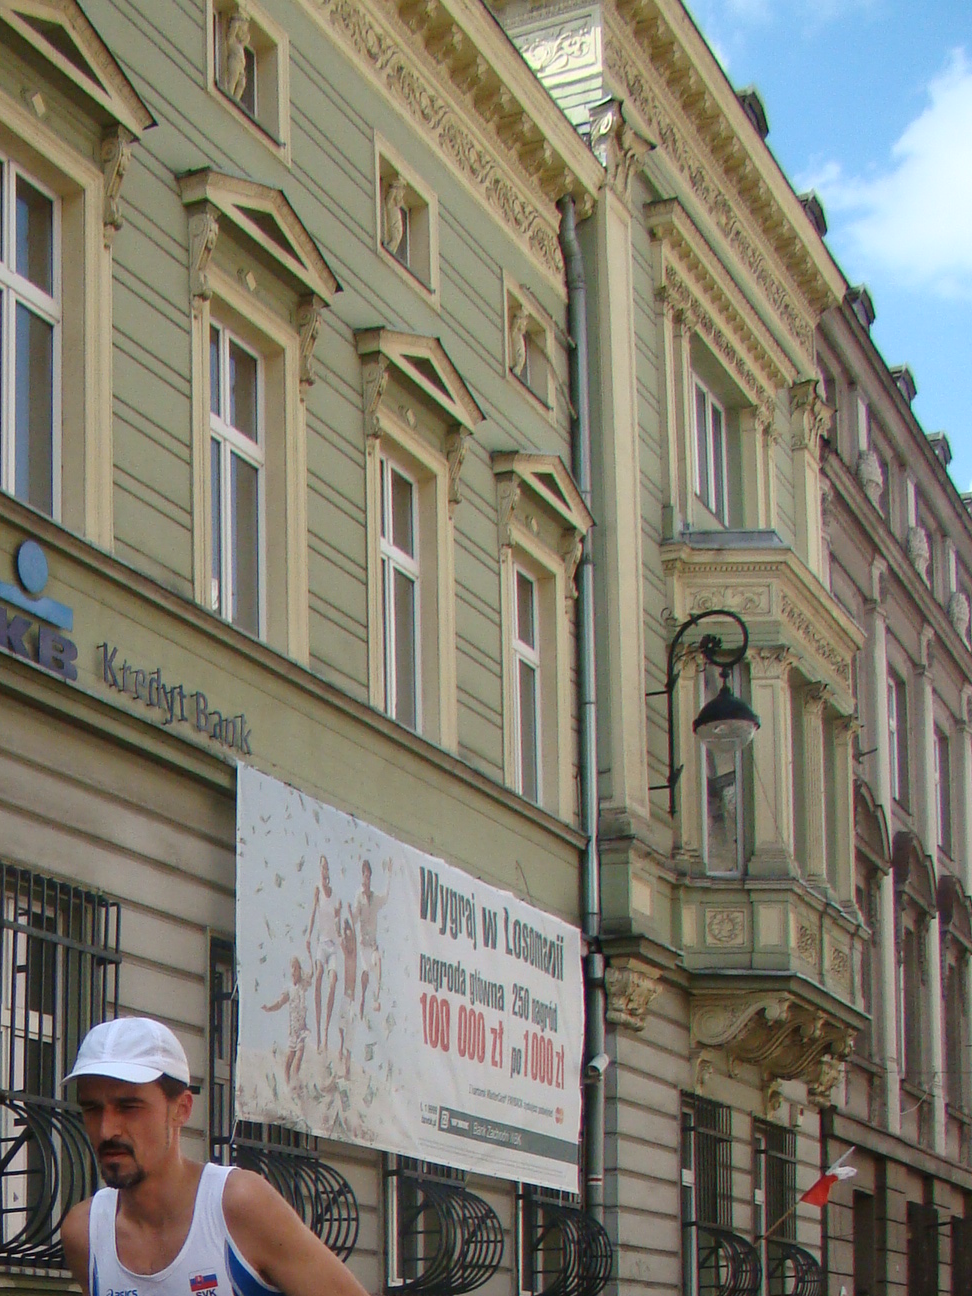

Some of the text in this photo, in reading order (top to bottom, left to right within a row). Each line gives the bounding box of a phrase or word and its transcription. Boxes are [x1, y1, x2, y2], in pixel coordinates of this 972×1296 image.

[96, 641, 253, 756] Kredyt Bank
[419, 866, 477, 951] Wygraj
[482, 906, 498, 950] w
[419, 953, 505, 1012] nagroda główna
[512, 983, 558, 1033] 250 nagród
[419, 992, 504, 1069] 100 000 zł
[510, 1029, 565, 1090] po 1 000 zł
